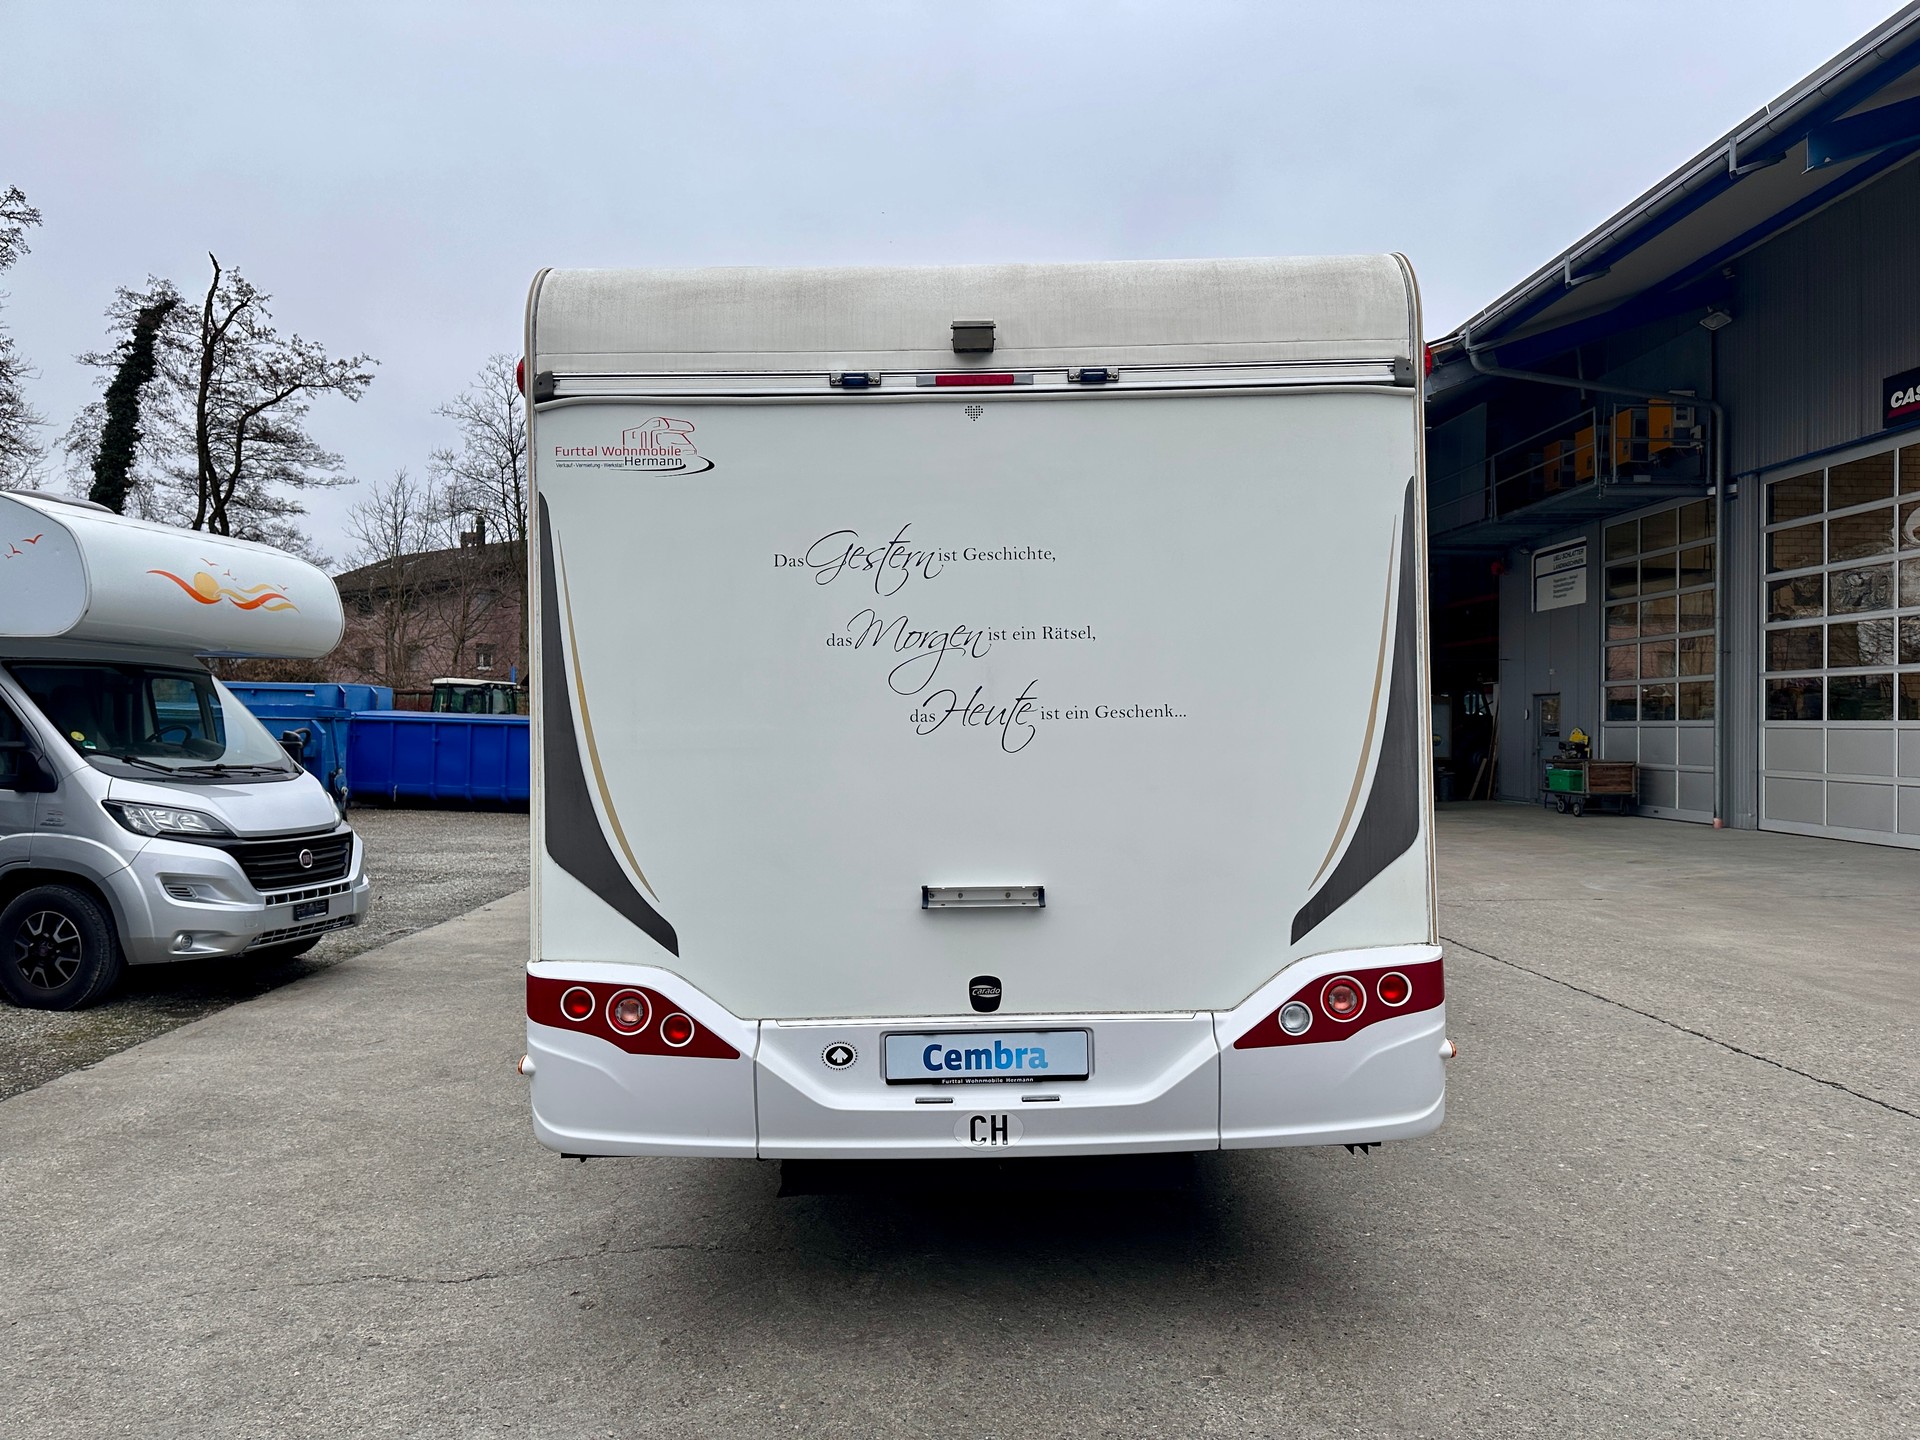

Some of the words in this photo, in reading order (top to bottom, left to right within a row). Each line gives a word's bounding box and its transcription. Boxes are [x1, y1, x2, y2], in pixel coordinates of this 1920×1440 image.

[555, 446, 598, 457] Furttal
[601, 445, 682, 457] Wohnmobile
[624, 456, 683, 467] Hermann
[773, 553, 804, 568] Das
[805, 522, 944, 597] Gestern
[938, 547, 958, 562] ist
[963, 546, 1056, 563] Geschichte,
[826, 632, 853, 647] das
[847, 608, 992, 695] Morgen
[988, 626, 1008, 641] ist
[1012, 625, 1037, 641] ein
[1042, 625, 1097, 642] Rätsel,
[909, 708, 936, 723] das
[915, 679, 1039, 753] Heute
[1040, 705, 1060, 720] ist
[1065, 703, 1090, 720] ein
[1095, 703, 1188, 719] Geschenk...
[923, 1040, 1048, 1072] Cembra
[969, 1114, 1008, 1146] CH
